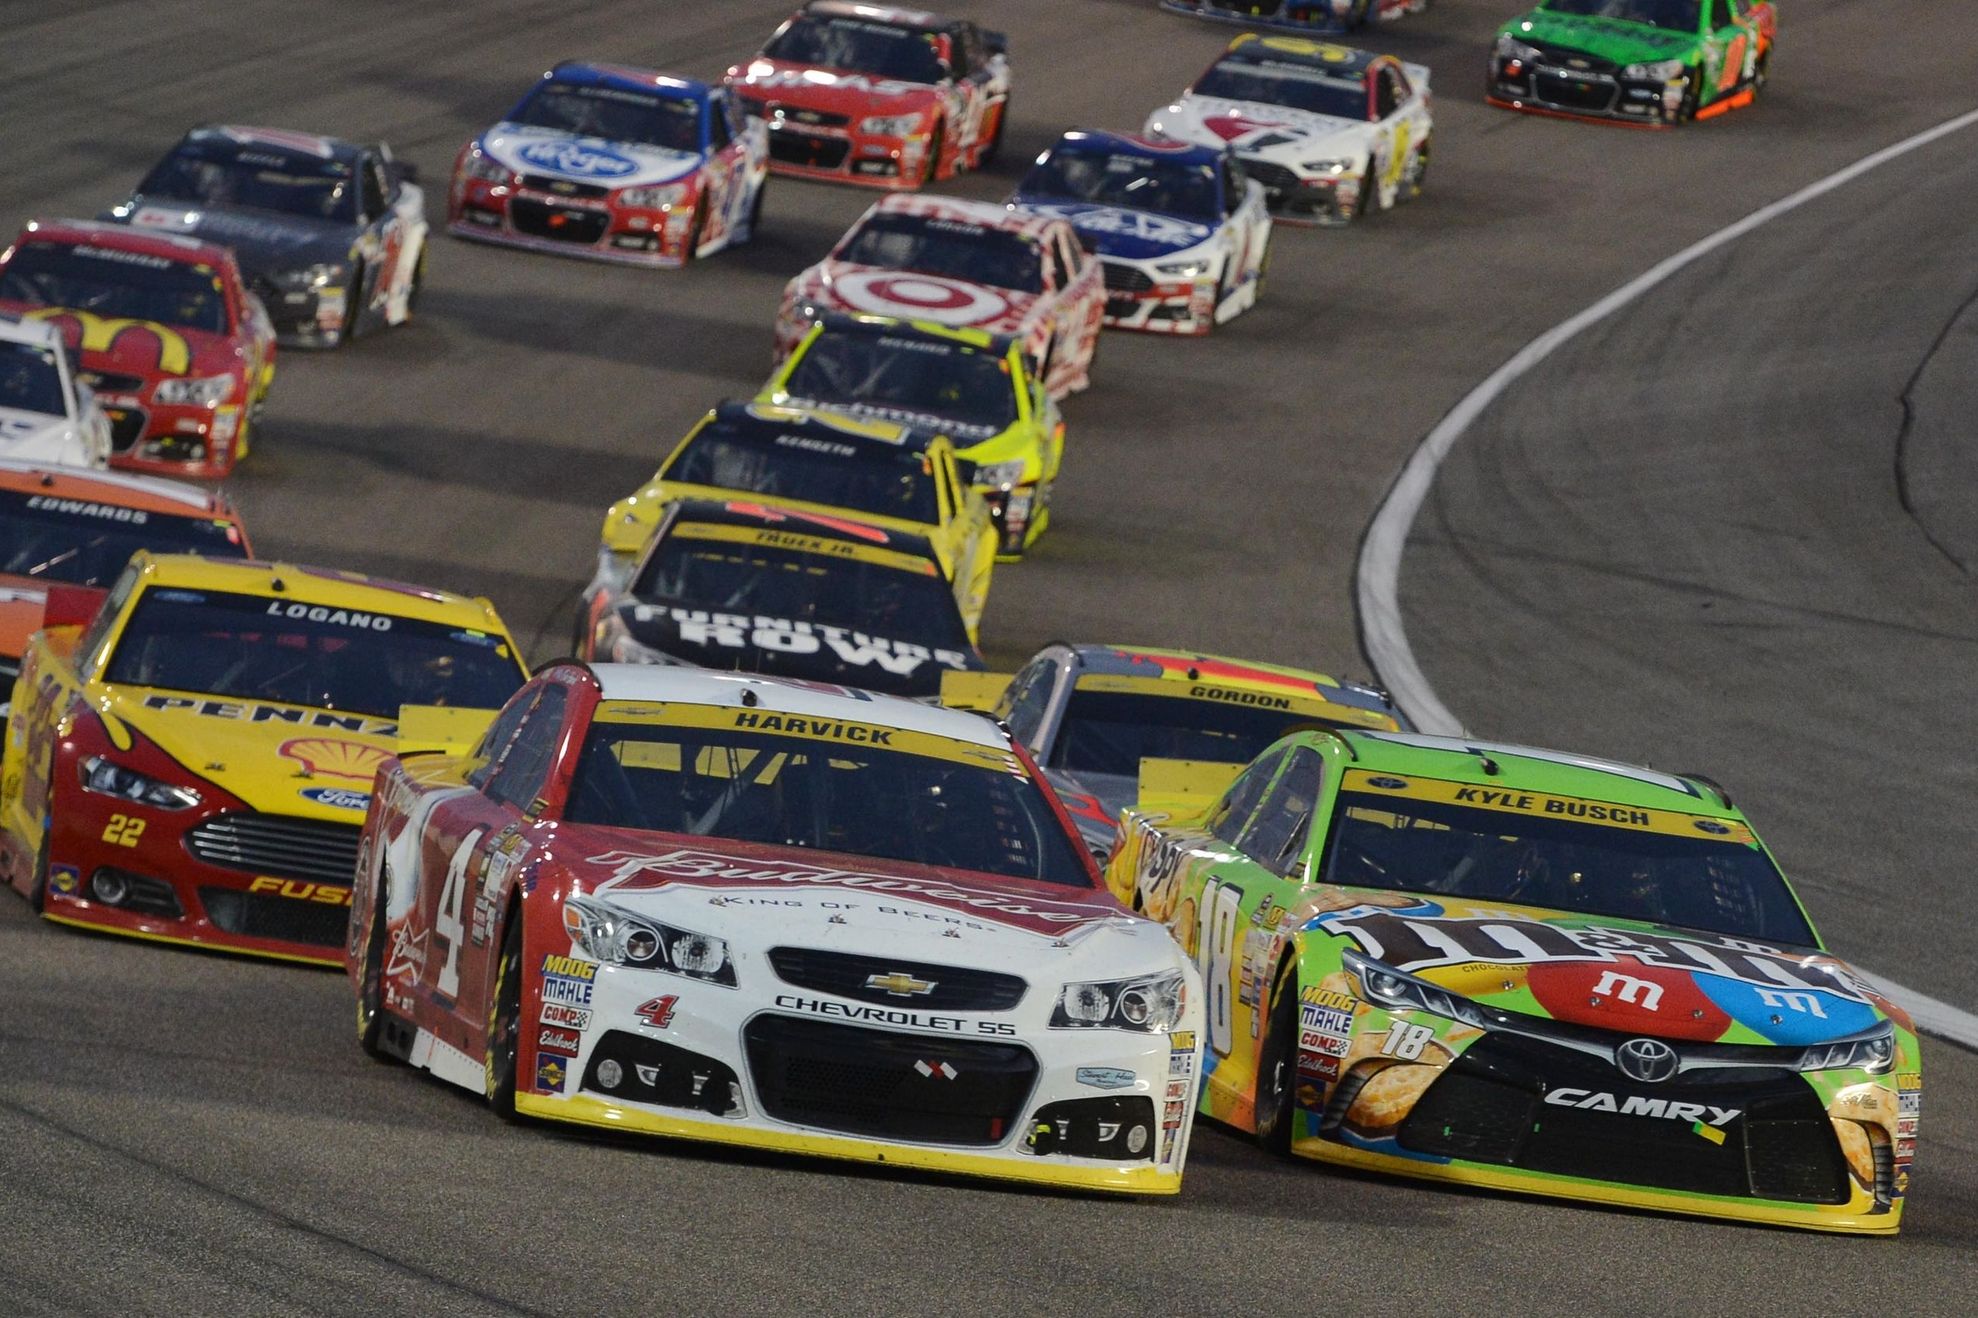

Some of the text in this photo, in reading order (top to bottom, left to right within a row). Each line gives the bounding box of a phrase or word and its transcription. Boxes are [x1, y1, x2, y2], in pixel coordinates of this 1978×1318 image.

[26, 495, 149, 525] EDWARDS
[266, 600, 393, 632] LOGANO
[634, 604, 967, 670] FURNITURE
[680, 621, 933, 676] ROW
[1190, 686, 1291, 709] GORDON
[143, 694, 400, 738] PENNZ
[734, 712, 893, 747] HARVICK
[1454, 786, 1650, 827] KYLE BUSCH
[101, 813, 147, 848] 22
[435, 820, 491, 998] 4
[724, 896, 803, 908] KING
[820, 901, 861, 911] OF
[543, 954, 596, 979] MOOG
[1200, 874, 1246, 1058] 18
[544, 979, 592, 1004] MAHLE
[1303, 986, 1355, 1012] MOOG
[1592, 970, 1665, 1012] m
[1754, 987, 1829, 1020] m
[543, 1006, 578, 1022] COMP
[634, 993, 680, 1029] 4
[775, 995, 1016, 1036] CHEVROLET SS
[1301, 1006, 1353, 1034] MAHLE
[1300, 1032, 1338, 1050] COMP
[1380, 1019, 1435, 1061] 18
[1544, 1087, 1742, 1127] CAMRY
